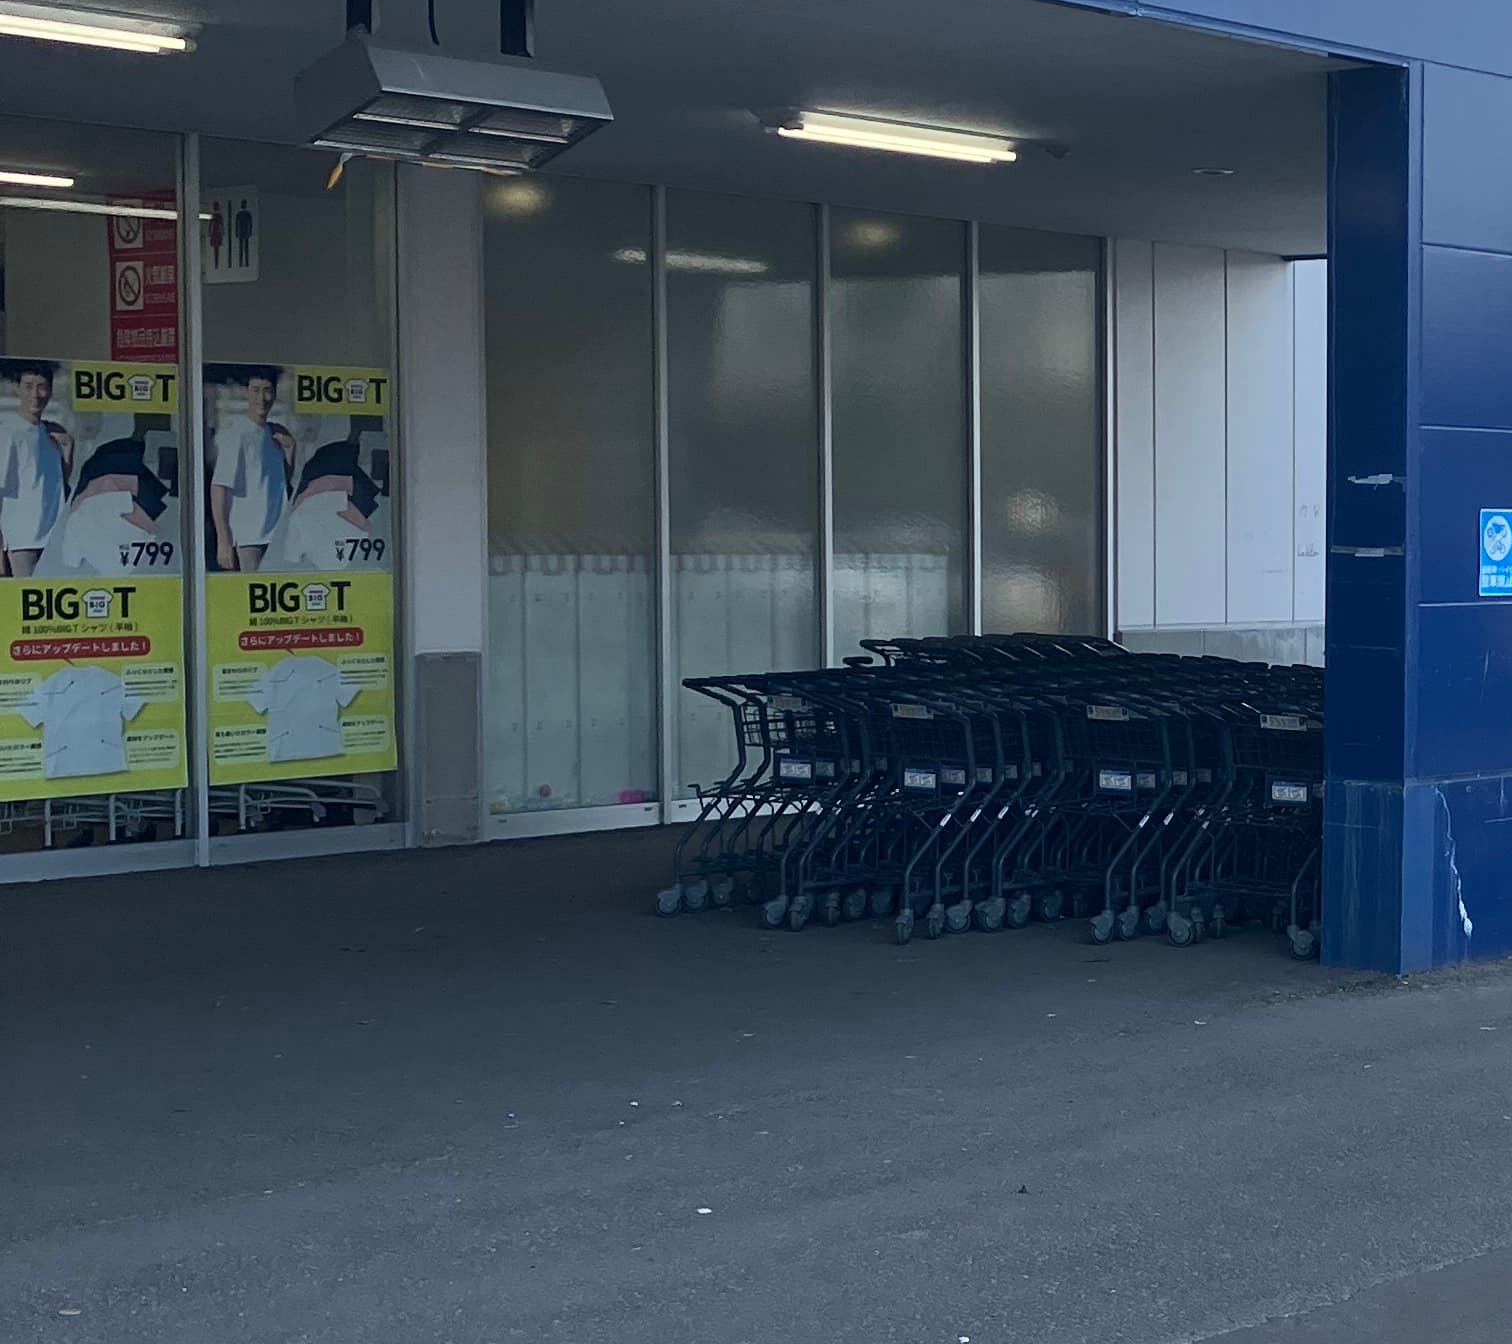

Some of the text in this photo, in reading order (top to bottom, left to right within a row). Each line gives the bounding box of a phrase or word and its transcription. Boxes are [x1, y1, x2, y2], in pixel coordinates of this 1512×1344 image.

[75, 370, 175, 402] BIG T
[297, 374, 388, 404] BIG T
[120, 541, 174, 567] ¥799
[335, 537, 386, 562] ¥799
[21, 586, 136, 621] BIG T
[249, 581, 351, 613] BIG T
